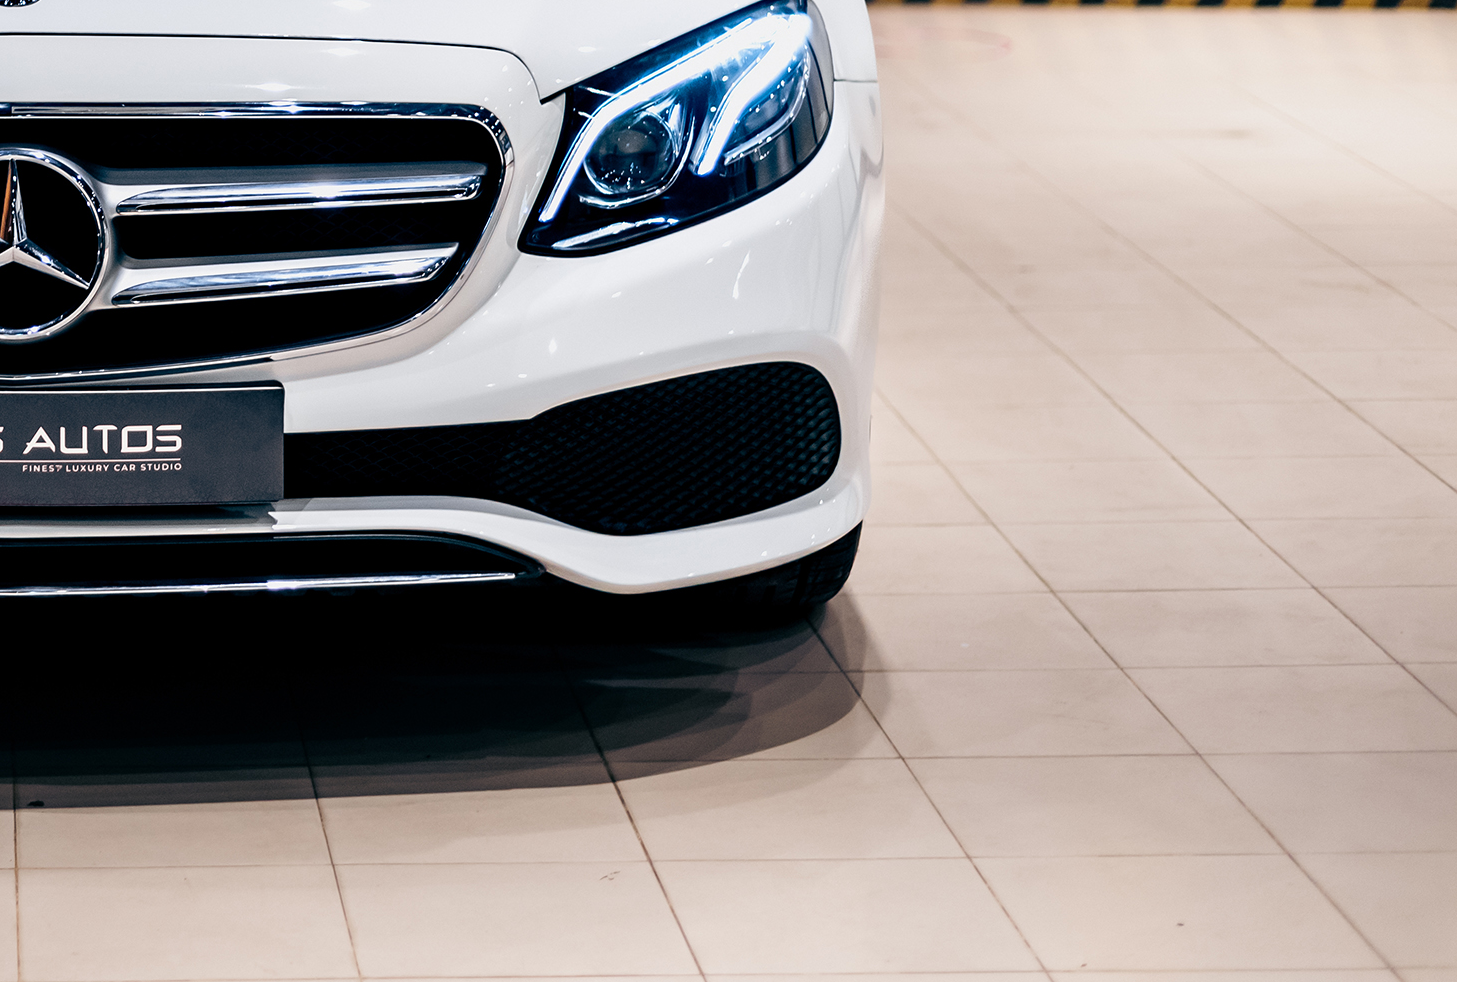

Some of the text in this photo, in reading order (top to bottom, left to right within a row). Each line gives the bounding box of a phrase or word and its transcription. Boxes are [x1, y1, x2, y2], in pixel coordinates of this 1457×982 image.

[22, 424, 182, 455] AUTOS
[65, 464, 110, 473] LUXURY
[113, 463, 136, 472] CAR
[140, 462, 182, 471] STUDIO
